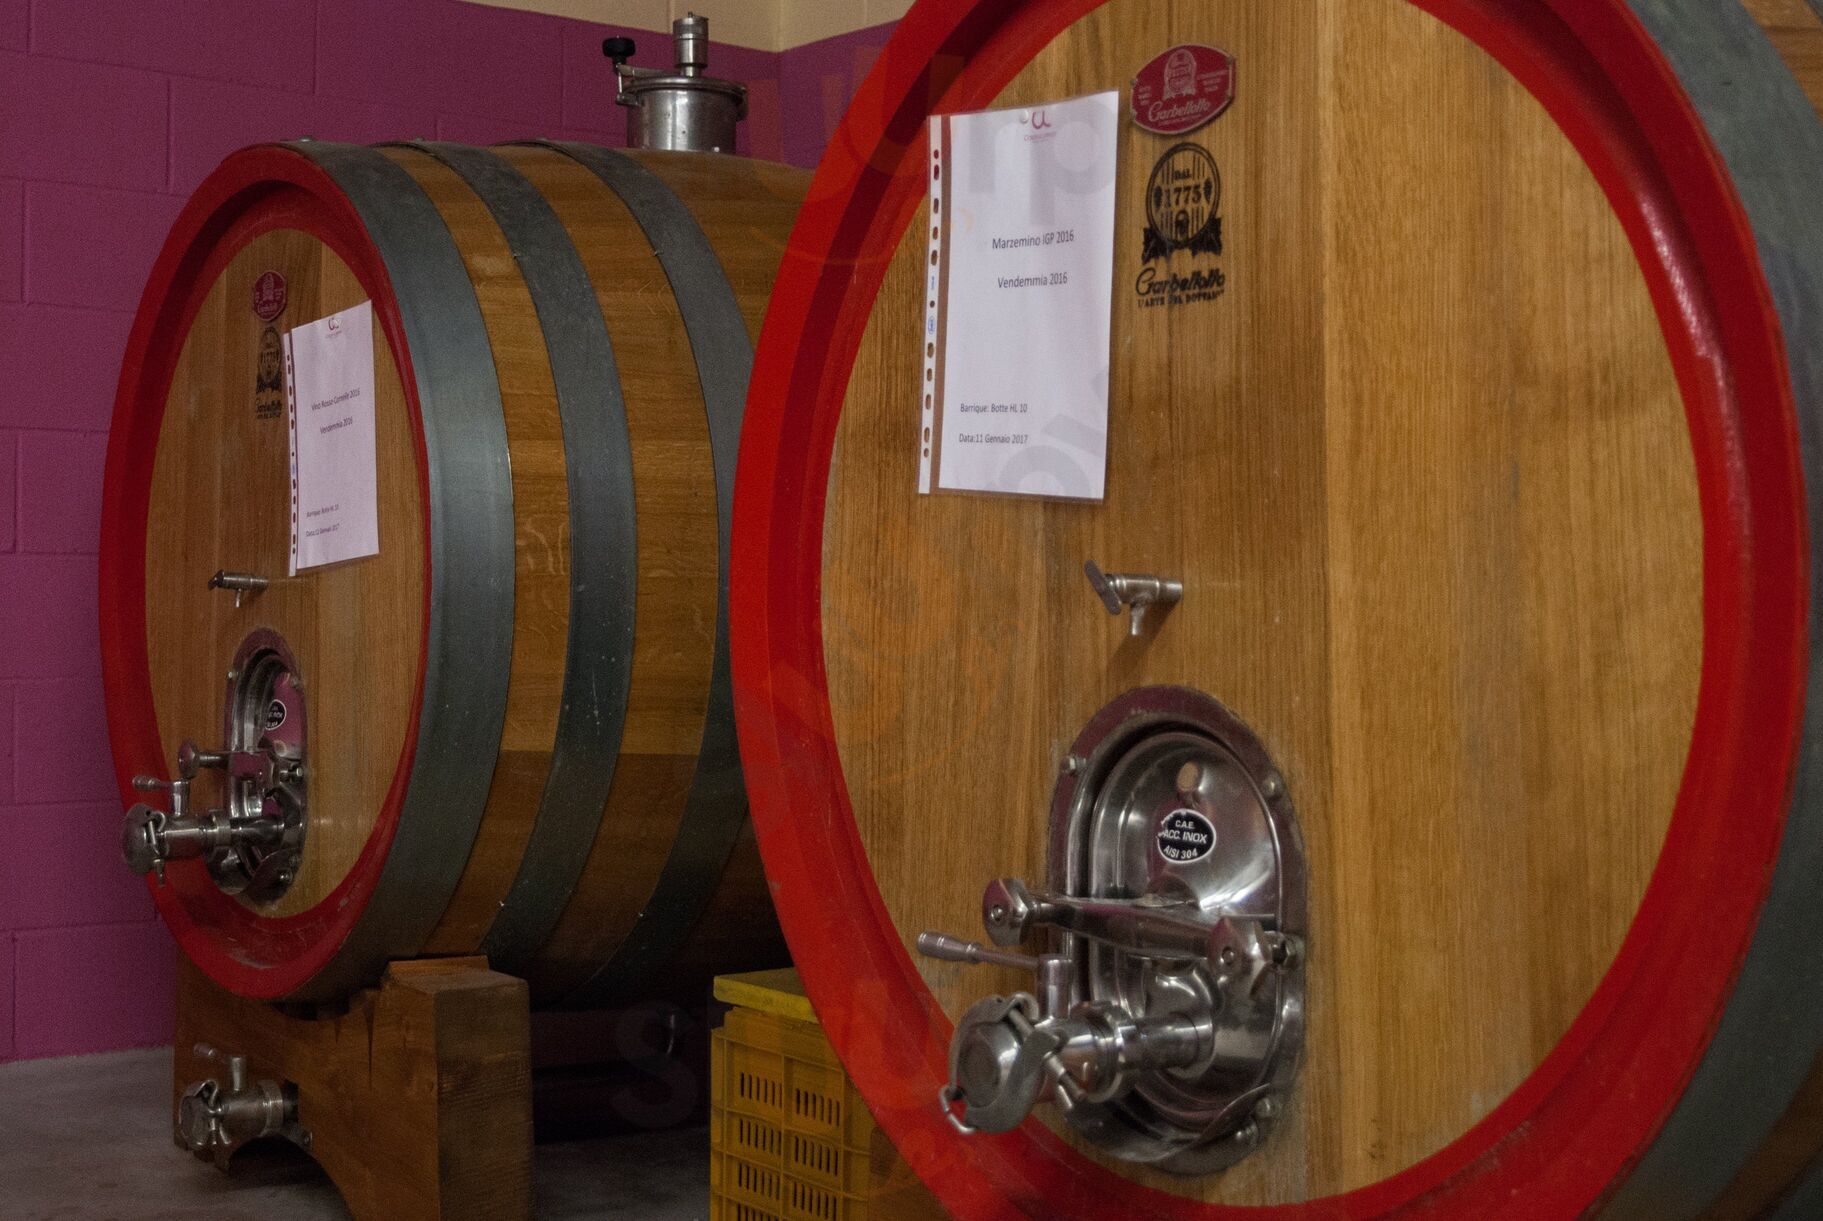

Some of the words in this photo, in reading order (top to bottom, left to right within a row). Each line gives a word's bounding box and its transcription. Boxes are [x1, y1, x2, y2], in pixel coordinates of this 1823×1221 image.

[1164, 184, 1202, 208] 1775
[992, 234, 1040, 249] Marzemino
[1043, 232, 1055, 245] IGP
[1056, 229, 1075, 243] 2016
[997, 274, 1048, 288] Vendemmia
[1049, 271, 1068, 285] 2016
[960, 403, 989, 414] Barrique:
[991, 403, 1008, 413] Botte
[1010, 404, 1018, 413] HL
[1019, 403, 1028, 413] 10
[984, 434, 1011, 444] Gennaio
[1011, 434, 1028, 445] 2017
[1183, 831, 1208, 844] INOX
[1163, 845, 1180, 858] AISI
[1181, 848, 1198, 859] 304
